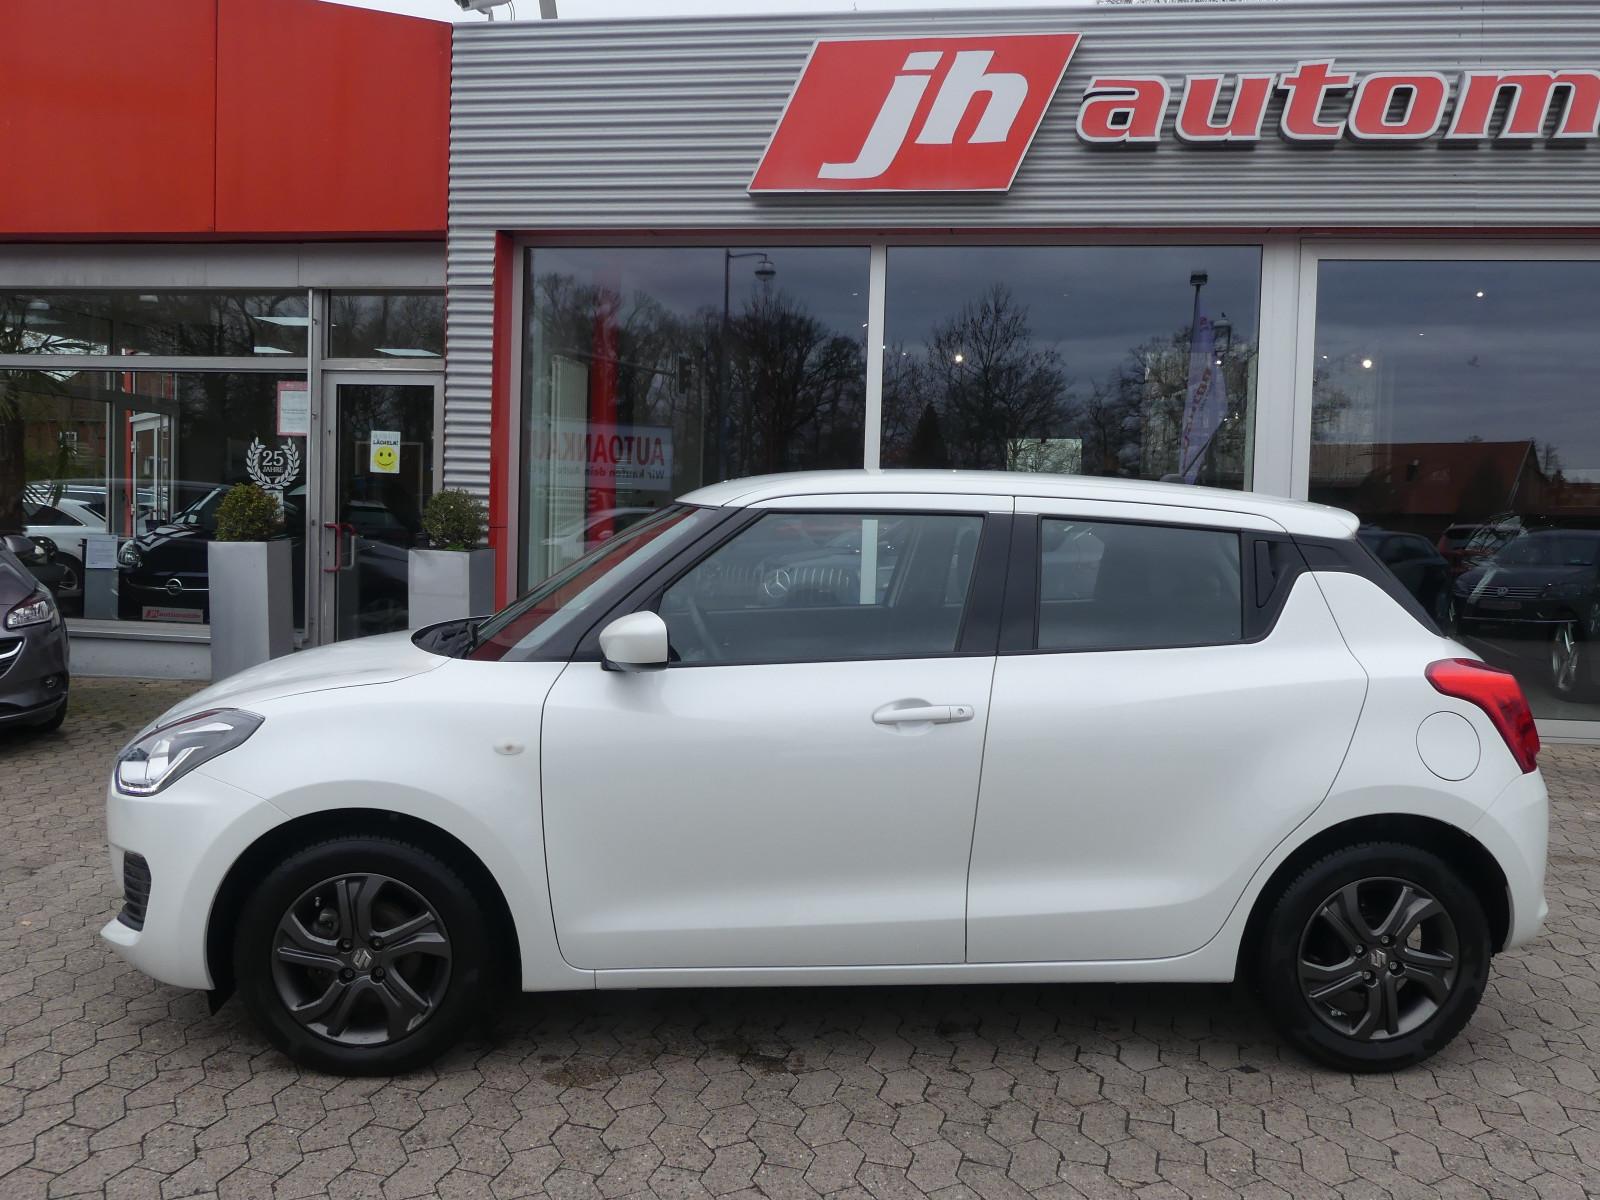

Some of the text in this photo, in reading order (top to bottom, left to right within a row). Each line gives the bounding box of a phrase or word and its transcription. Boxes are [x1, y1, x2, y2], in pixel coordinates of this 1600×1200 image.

[817, 50, 1600, 179] jh autom
[262, 450, 284, 466] 25
